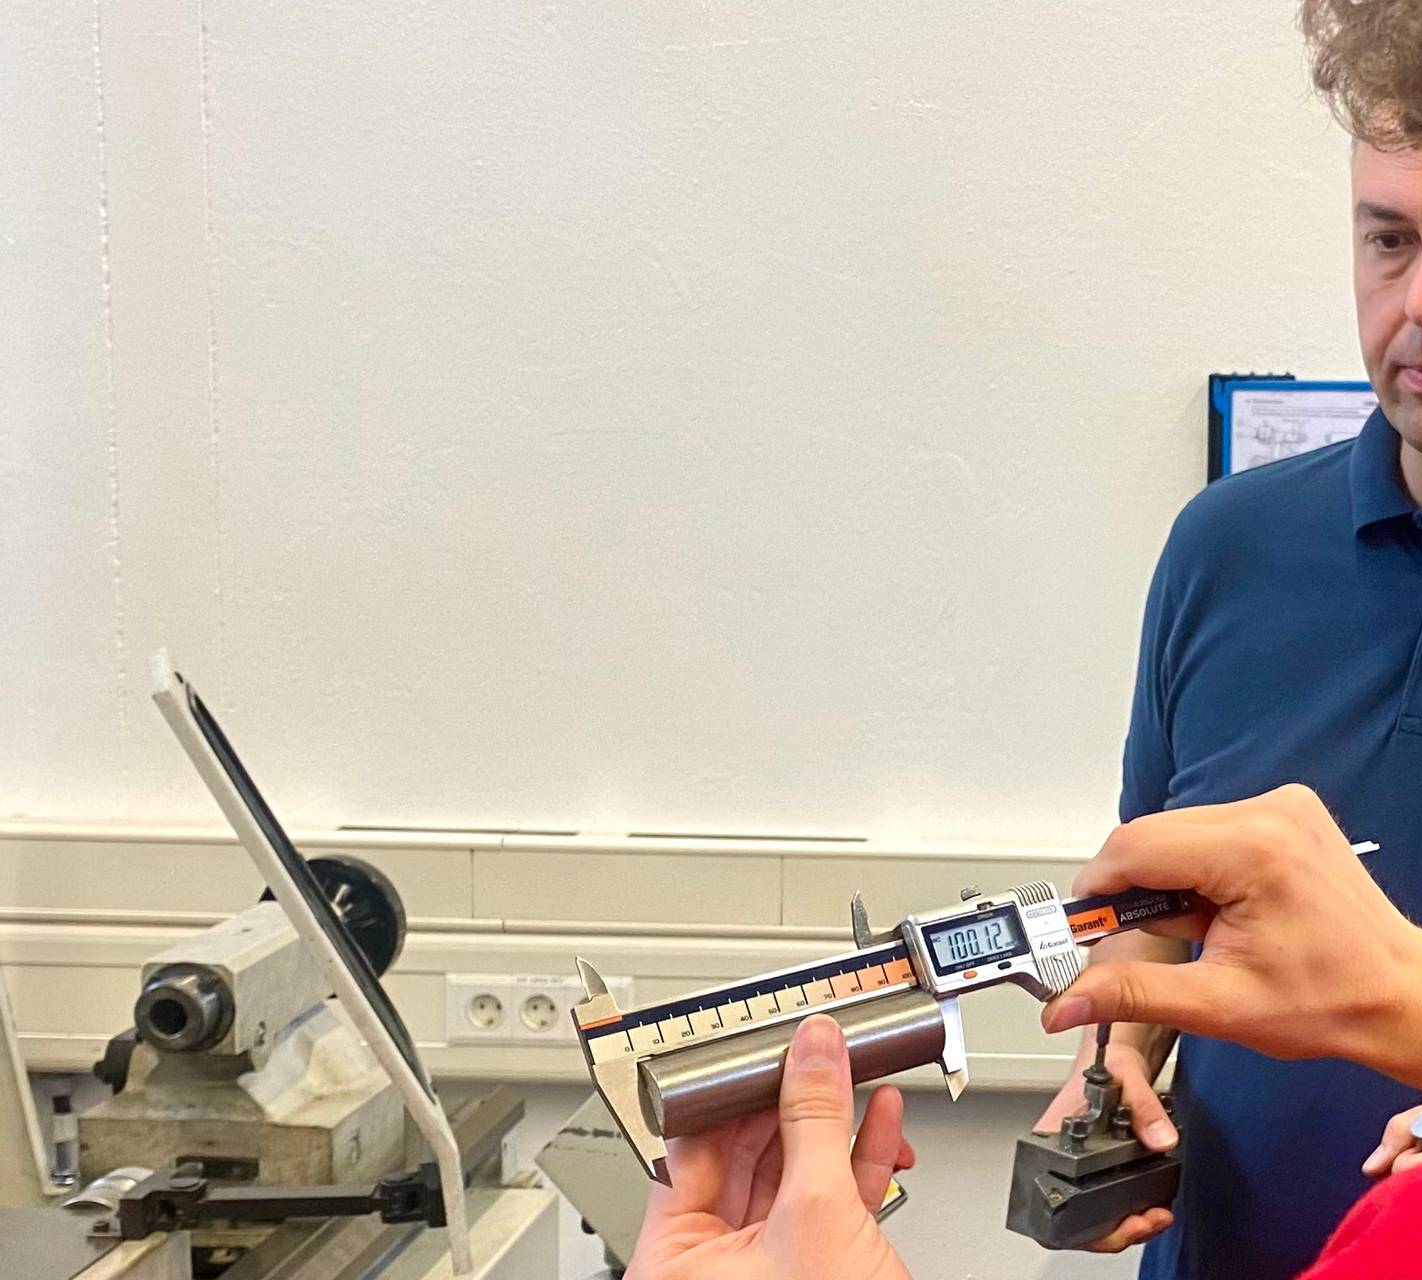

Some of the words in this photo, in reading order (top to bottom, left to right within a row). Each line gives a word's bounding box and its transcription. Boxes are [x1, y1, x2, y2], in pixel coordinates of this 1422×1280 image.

[1120, 902, 1169, 923] ABSOLUTE
[948, 922, 1003, 961] 100.12
[681, 1030, 691, 1038] 20
